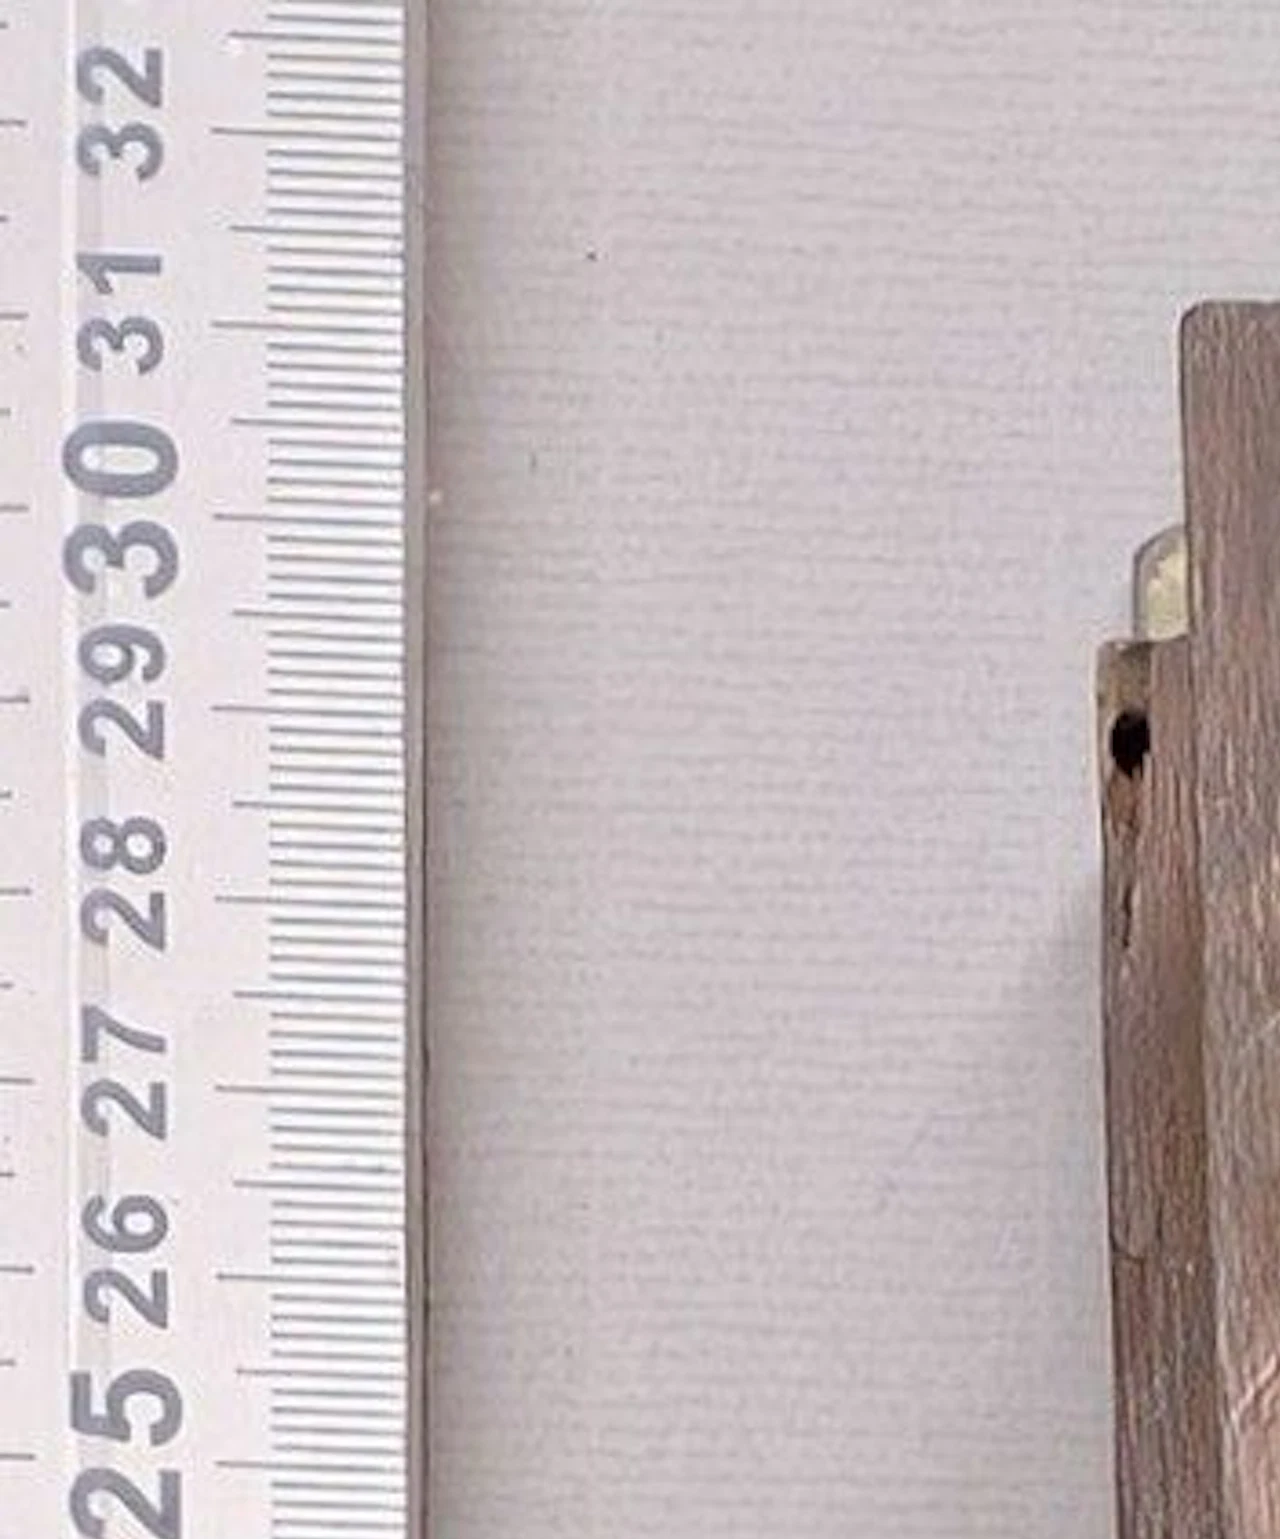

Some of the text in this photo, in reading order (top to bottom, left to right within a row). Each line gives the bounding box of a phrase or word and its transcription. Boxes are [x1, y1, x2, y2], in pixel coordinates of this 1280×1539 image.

[77, 47, 163, 181] 32
[77, 253, 163, 375] 31
[63, 422, 178, 598] 30
[78, 627, 165, 761] 29
[80, 817, 166, 951] 28
[81, 1005, 167, 1140] 27
[82, 1195, 168, 1329] 26
